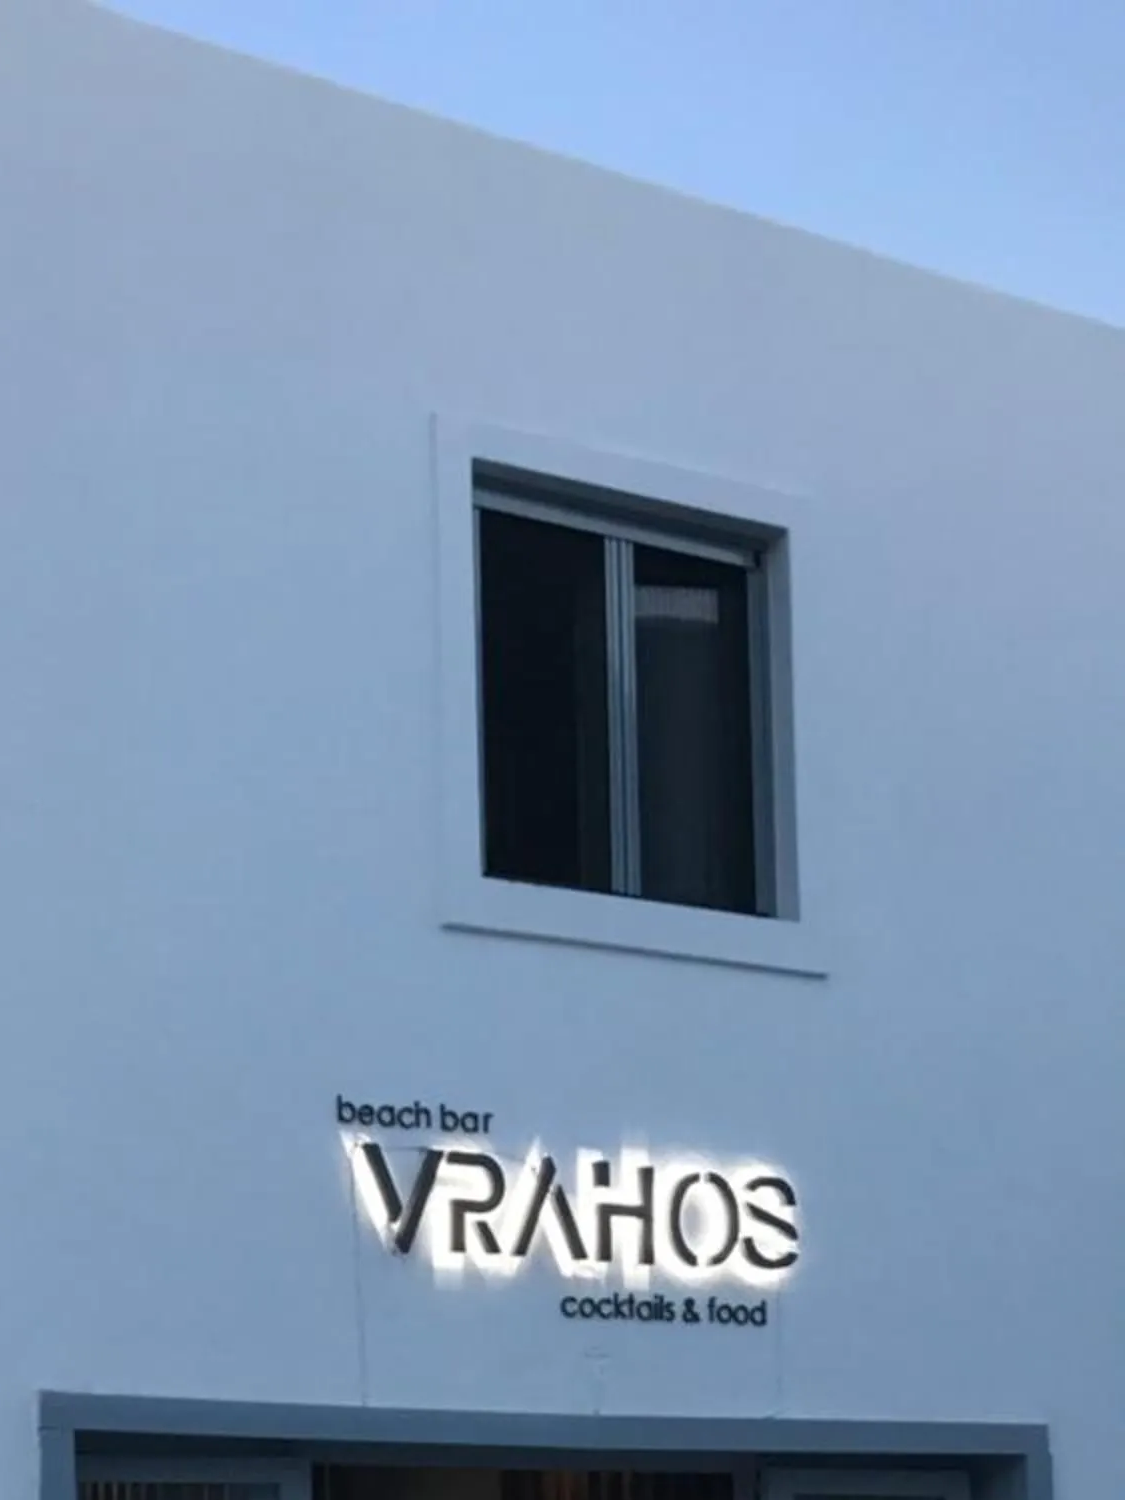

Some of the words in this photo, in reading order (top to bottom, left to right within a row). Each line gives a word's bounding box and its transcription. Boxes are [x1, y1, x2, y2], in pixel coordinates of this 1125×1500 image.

[336, 1094, 432, 1129] beach
[440, 1103, 494, 1133] bar
[361, 1142, 799, 1270] VRAHOS
[560, 1292, 675, 1322] cocktails
[682, 1297, 700, 1323] &
[707, 1296, 768, 1326] food
